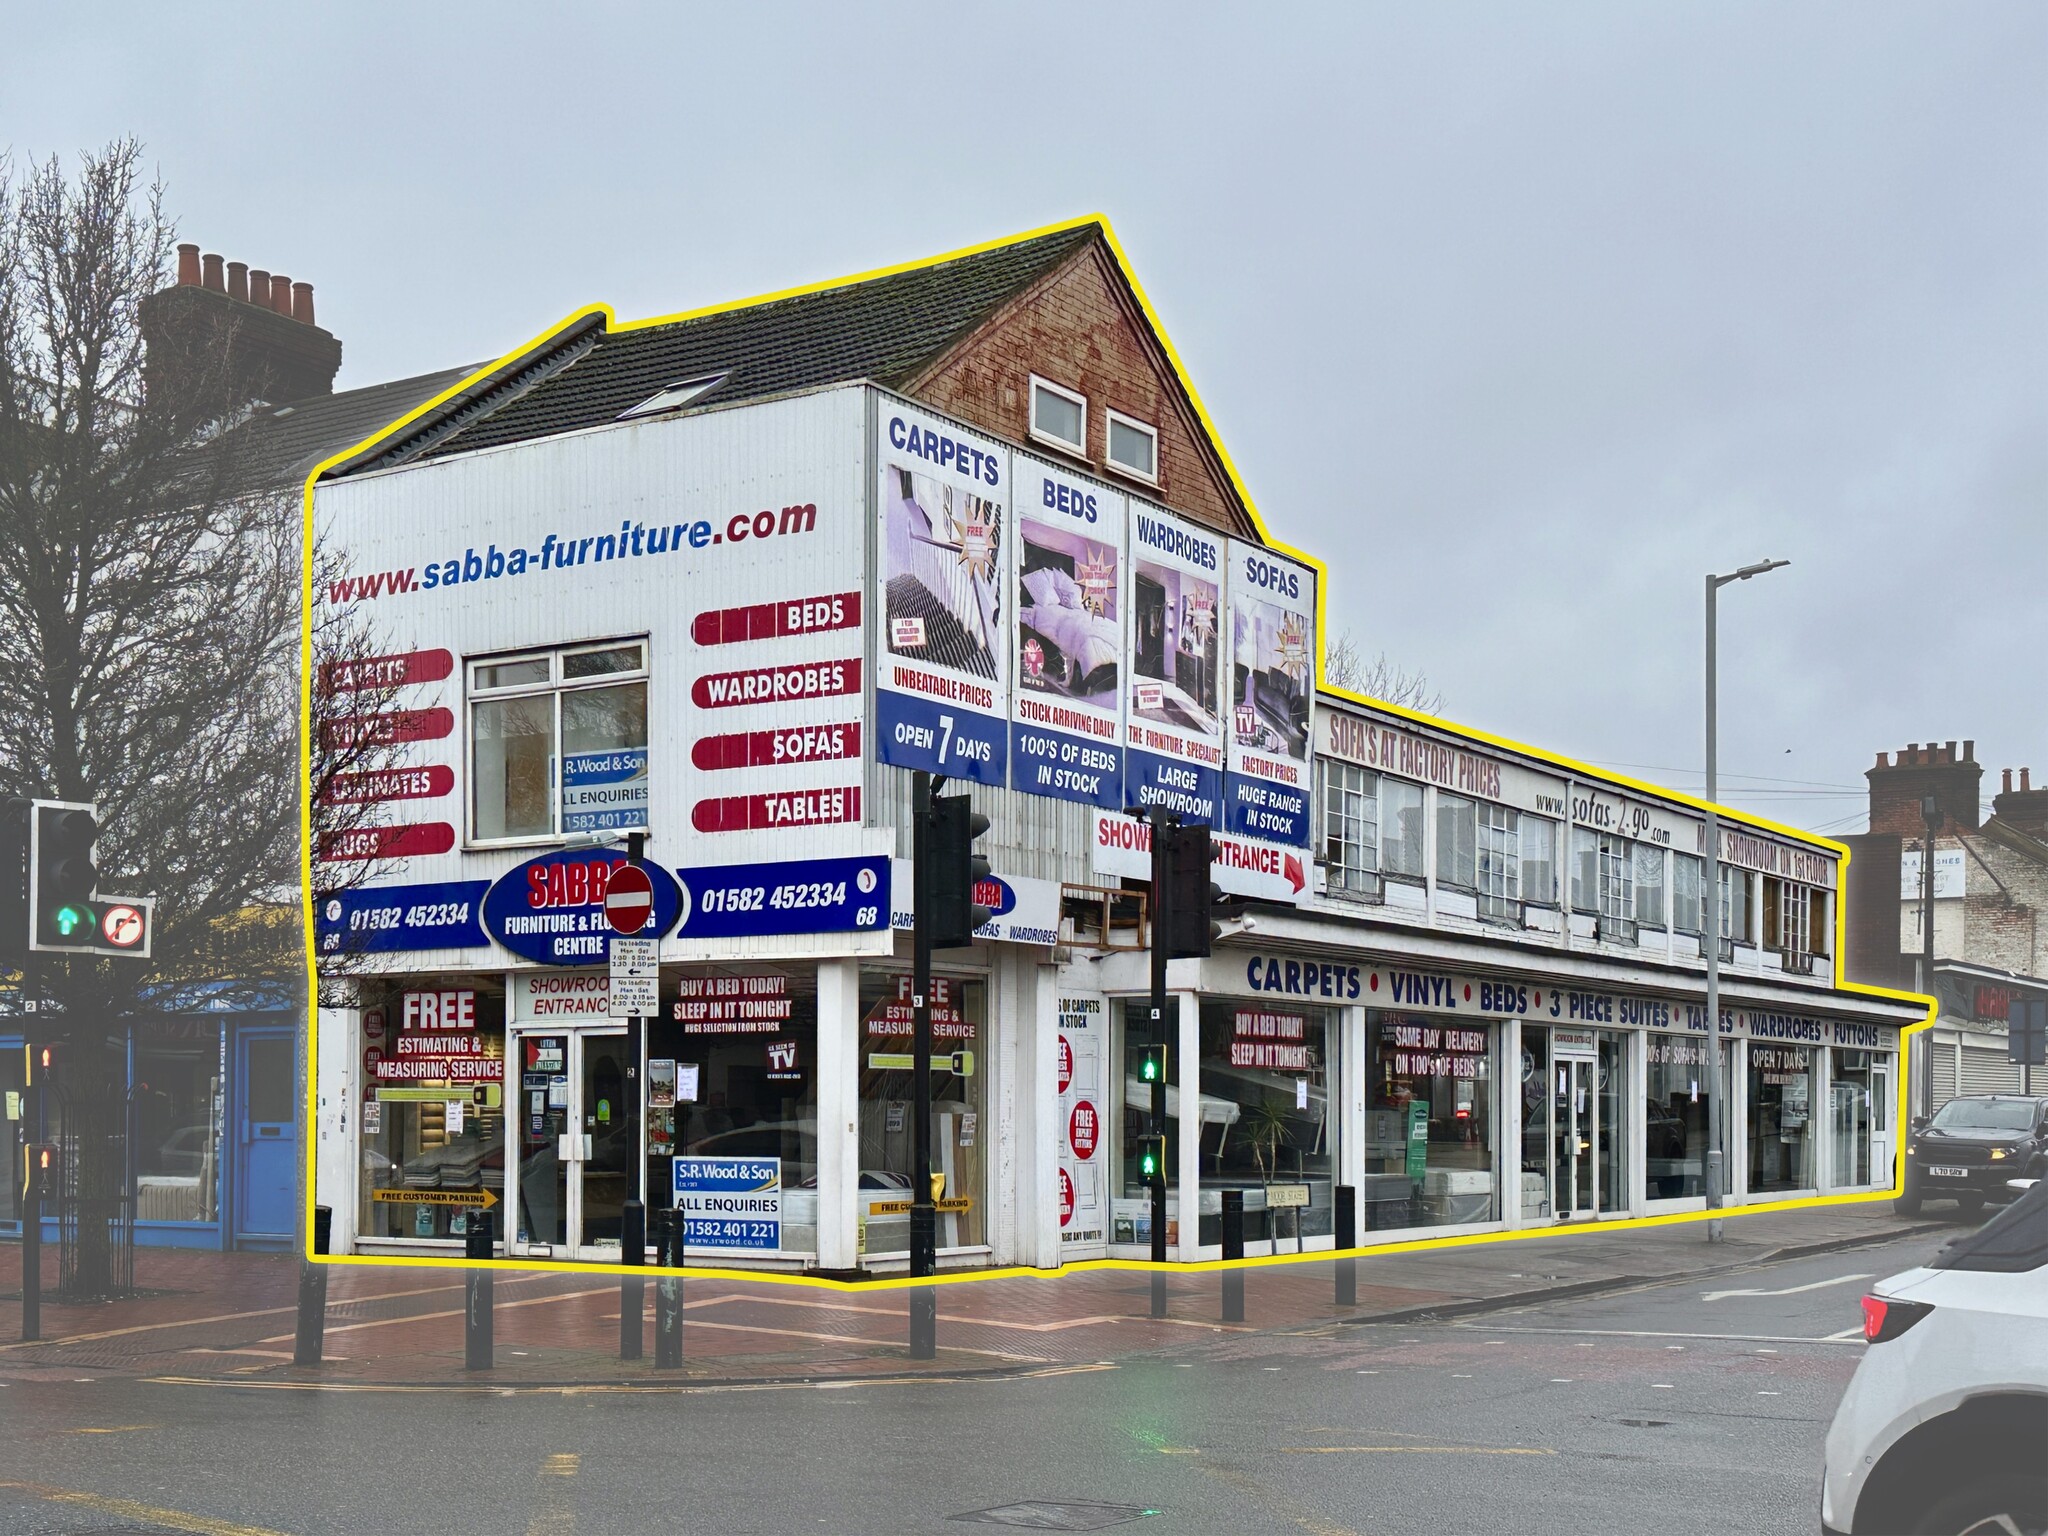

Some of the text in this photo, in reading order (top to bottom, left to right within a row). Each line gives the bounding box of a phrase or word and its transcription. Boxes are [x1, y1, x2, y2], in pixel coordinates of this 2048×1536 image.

[889, 417, 998, 486] CARPETS
[1042, 478, 1097, 524] BEDS
[329, 503, 816, 604] www.sabba-furniture.com
[1137, 515, 1217, 571] WARDROBES
[1246, 556, 1299, 599] SOFAS
[787, 599, 843, 630] BEDS
[708, 666, 843, 703] WARDROBES
[894, 666, 992, 709] UNBEATABLE PRICES
[1020, 699, 1115, 739] STOCK ARRIVING DAILY
[1237, 713, 1252, 732] TV
[773, 730, 843, 758] SOFAS
[895, 715, 991, 764] OPEN 7 DAYS
[1129, 725, 1220, 765] THE FURNITURE SPECIALIST
[577, 755, 645, 773] Wood & Son
[1020, 735, 1115, 772] 100'S OF BEDS
[1330, 713, 1500, 800] SOFA'S AT FACTORY PRICES
[1037, 765, 1100, 795] IN STOCK
[1158, 765, 1198, 790] LARGE
[1242, 755, 1297, 784] FACTORY PRICES
[581, 787, 647, 804] ENQUIRIES
[1140, 786, 1212, 818] SHOWROOM
[1238, 784, 1301, 814] HUGE RANGE
[598, 812, 620, 827] 401
[624, 811, 645, 825] 221
[765, 793, 843, 823] TABLES
[1247, 810, 1293, 835] IN STOCK
[1210, 838, 1279, 874] NTRANCE
[1727, 833, 1828, 885] SHOWROOM ON 1st FLOOR
[702, 882, 846, 913] 01582 452334
[350, 902, 469, 931] 01582 452334
[505, 914, 588, 935] FURNITURE &
[856, 907, 878, 926] 68
[554, 936, 603, 956] CENTRE
[1009, 925, 1057, 944] WARDROBES
[530, 976, 609, 994] SHOWROO
[680, 976, 785, 996] BUY A BED TODAY!
[403, 991, 474, 1029] FREE
[534, 998, 607, 1015] ENTRANC
[674, 1000, 792, 1020] SLEEP IN IT TONIGHT
[914, 997, 920, 1005] 3
[1062, 998, 1100, 1013] OF CARPETS
[1247, 956, 1360, 999] CARPETS
[1389, 972, 1456, 1008] VINYL
[1480, 981, 1528, 1014] BEDS
[1550, 989, 1561, 1018] 3
[1569, 992, 1612, 1022] PIECE
[1620, 998, 1669, 1027] SUITES
[1686, 1005, 1733, 1033] TABES
[1749, 1012, 1821, 1041] WARDROBES
[1834, 1021, 1879, 1047] FUTTONS
[684, 1021, 780, 1033] HUGE SELECTION FROM STOCK
[951, 1009, 959, 1022] &
[1066, 1014, 1087, 1028] STOCK
[1236, 1013, 1303, 1038] BUY A BED TODAY!
[933, 1023, 975, 1037] SERVICE
[1395, 1026, 1421, 1048] SAME
[1423, 1028, 1440, 1049] DAY
[1445, 1030, 1484, 1051] DELIVERY
[398, 1036, 481, 1053] ESTIMATING &
[1231, 1043, 1307, 1068] SLEEP IN IT TONIGHT
[1661, 1045, 1670, 1064] OF
[1673, 1046, 1696, 1066] SOFA'S
[377, 1061, 448, 1078] MEASURING
[451, 1061, 502, 1078] SERVICE
[769, 1049, 795, 1070] TV
[1395, 1054, 1475, 1078] ON 100's OF BEDS
[1753, 1049, 1804, 1070] OPEN 7 DAYS
[1076, 1110, 1093, 1127] FREE
[679, 1164, 773, 1180] S.R. Wood & Son
[449, 1194, 485, 1203] PARKING
[677, 1197, 778, 1213] ALL ENQUIRIES
[881, 1203, 899, 1211] FREE
[723, 1222, 775, 1238] 401 221
